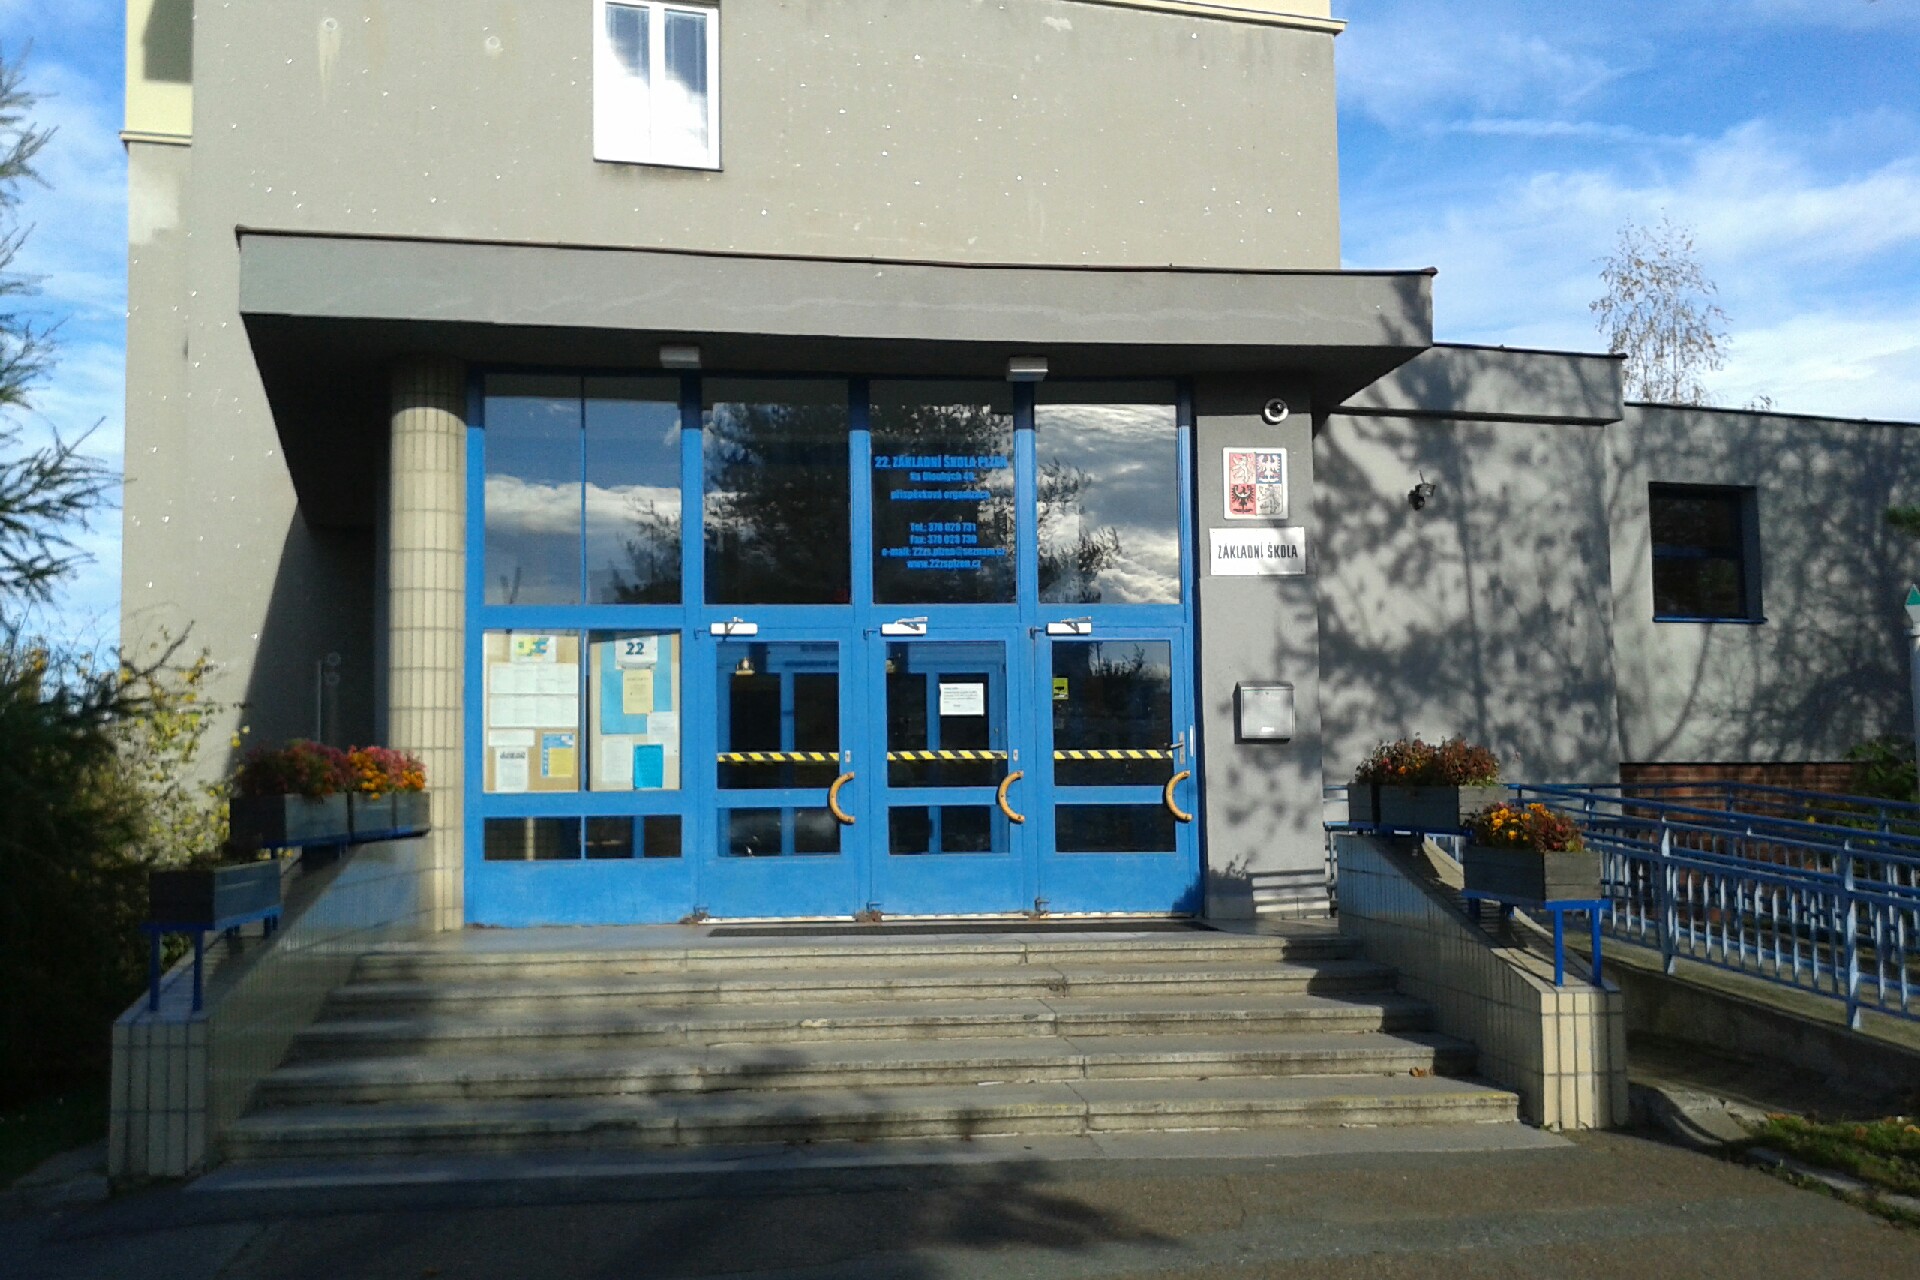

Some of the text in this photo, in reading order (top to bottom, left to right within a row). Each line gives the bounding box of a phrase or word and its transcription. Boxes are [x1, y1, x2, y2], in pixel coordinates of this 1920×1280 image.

[875, 456, 890, 468] 22.
[893, 454, 941, 468] ZÁKLADNÍ
[1218, 542, 1298, 559] ZÁKLADNÍ ŠKOLA
[626, 642, 645, 655] 22
